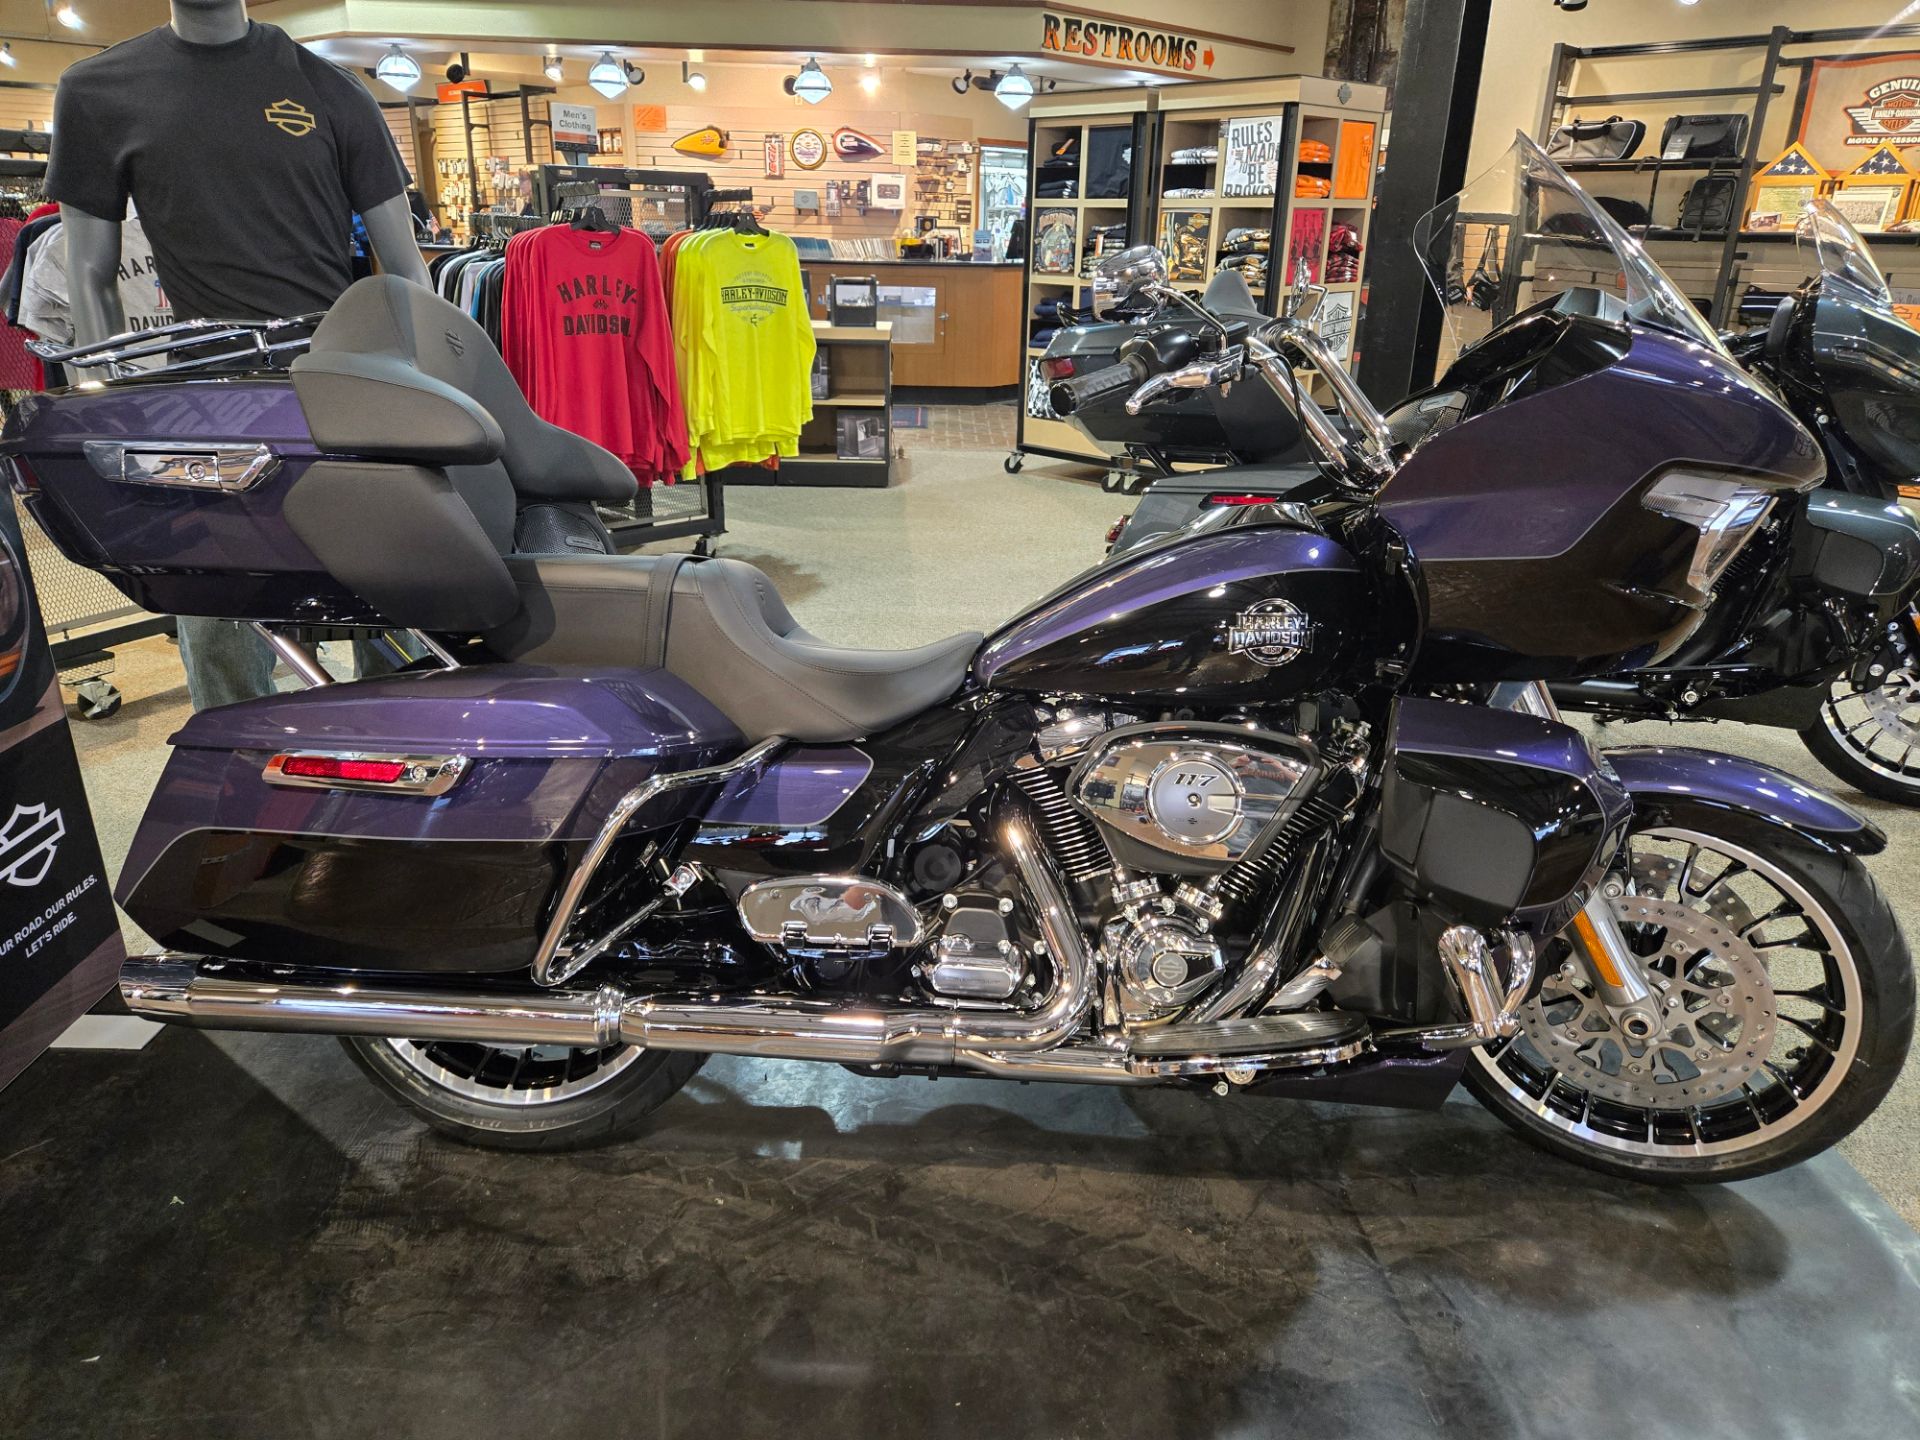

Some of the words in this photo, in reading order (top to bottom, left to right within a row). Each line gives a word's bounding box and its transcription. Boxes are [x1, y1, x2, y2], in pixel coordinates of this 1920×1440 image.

[1042, 14, 1197, 71] RESTROOMS
[563, 110, 587, 120] Men's
[559, 119, 592, 132] Clothing
[1231, 121, 1273, 149] RULES
[1847, 137, 1878, 145] MOTOR
[1248, 163, 1265, 185] BE
[1233, 630, 1312, 649] DAVIDSON
[1173, 772, 1219, 788] 117
[14, 916, 45, 944] ROAD.
[45, 899, 66, 920] OUR
[65, 874, 98, 903] RULES.
[25, 930, 53, 958] LET'S
[53, 911, 78, 938] RIDE.
